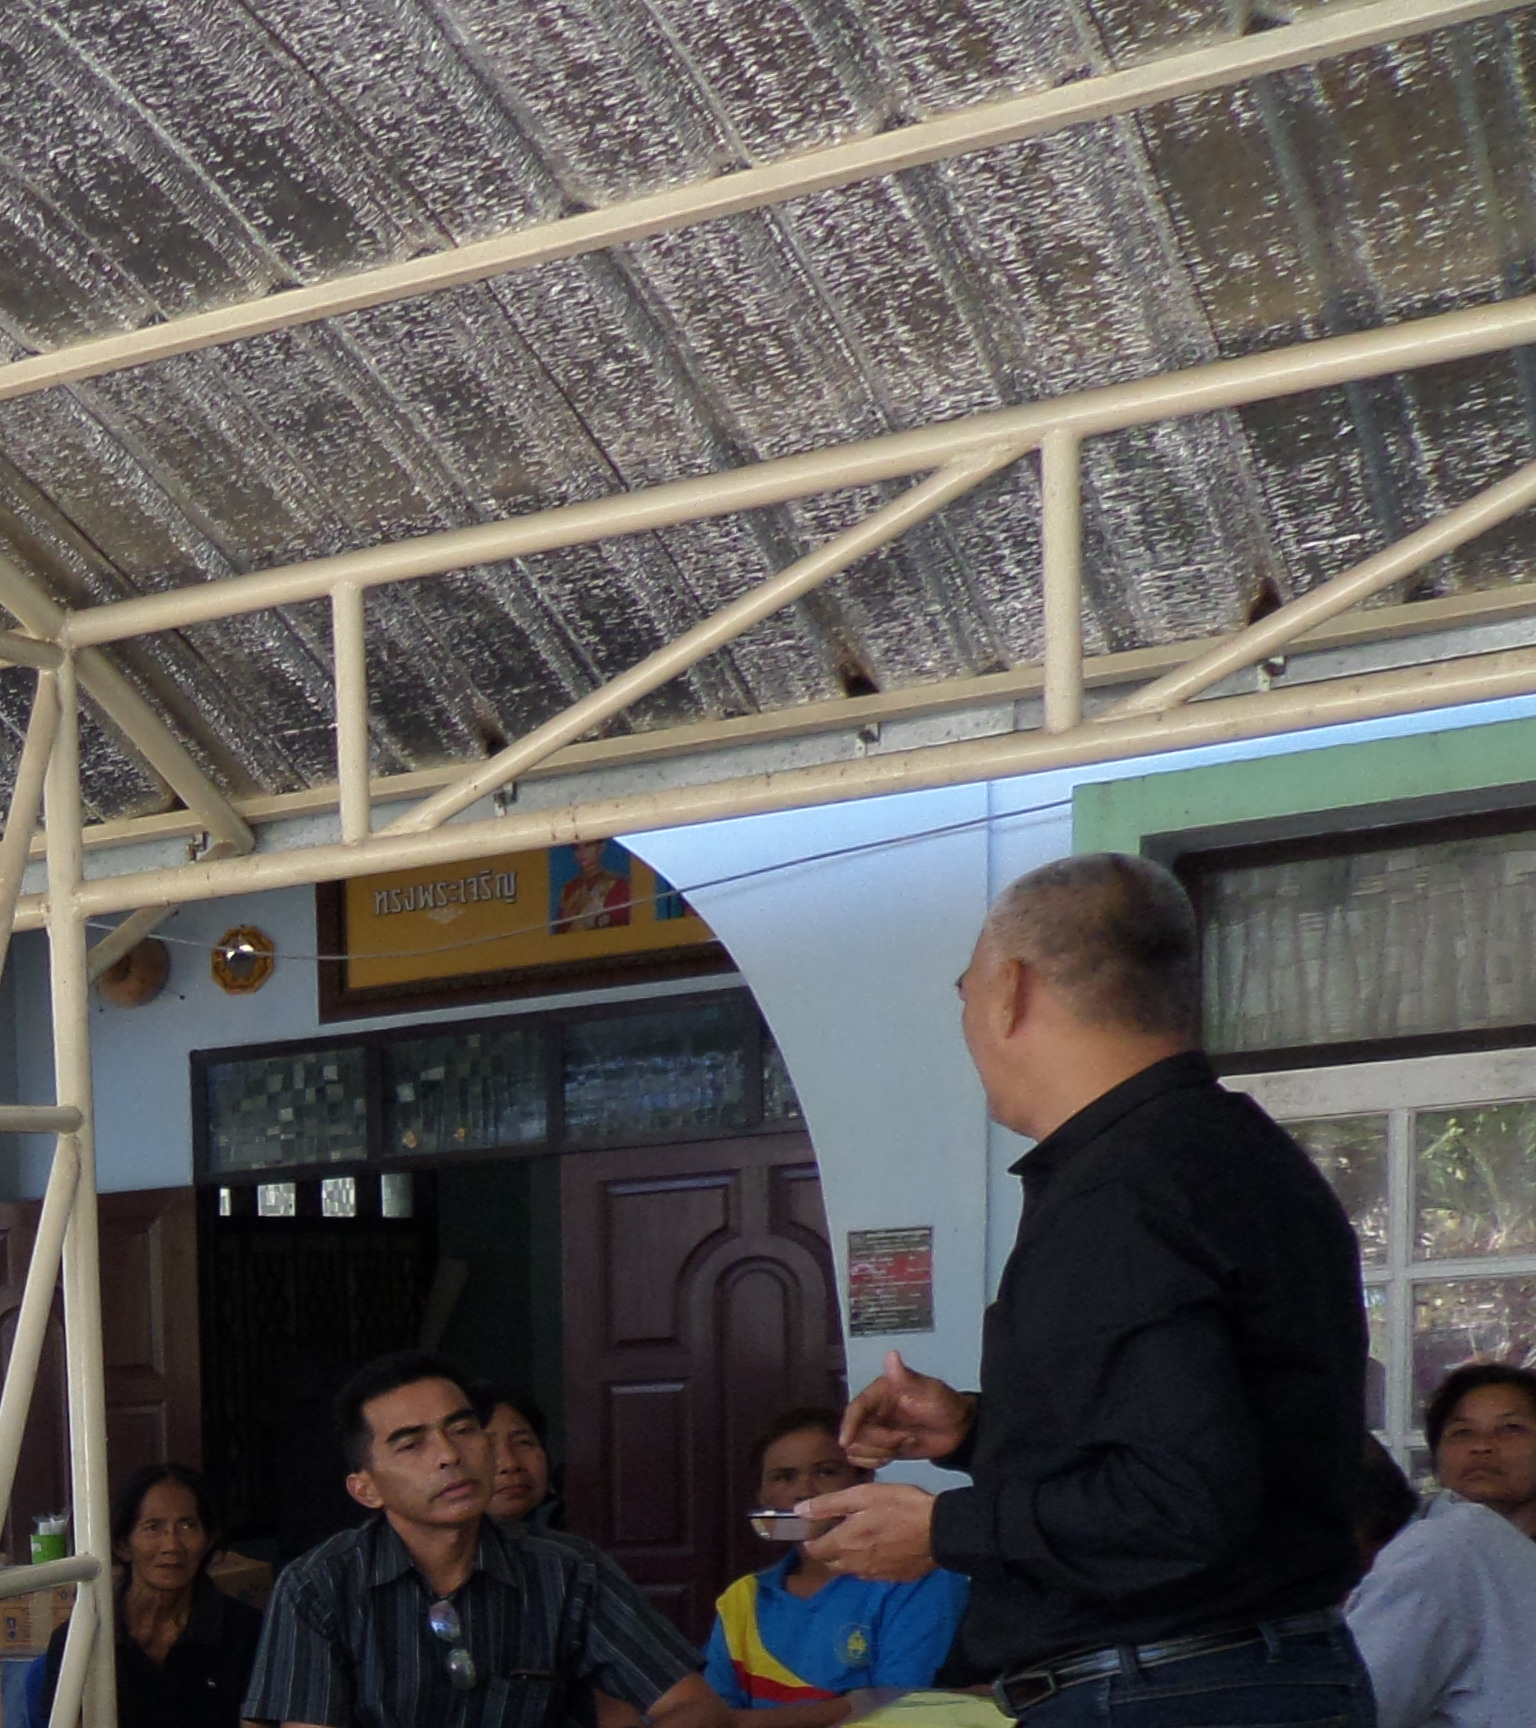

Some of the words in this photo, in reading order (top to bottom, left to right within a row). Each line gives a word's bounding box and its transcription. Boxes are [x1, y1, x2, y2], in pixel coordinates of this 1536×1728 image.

[373, 868, 518, 916] ทรงพระเจริญ
